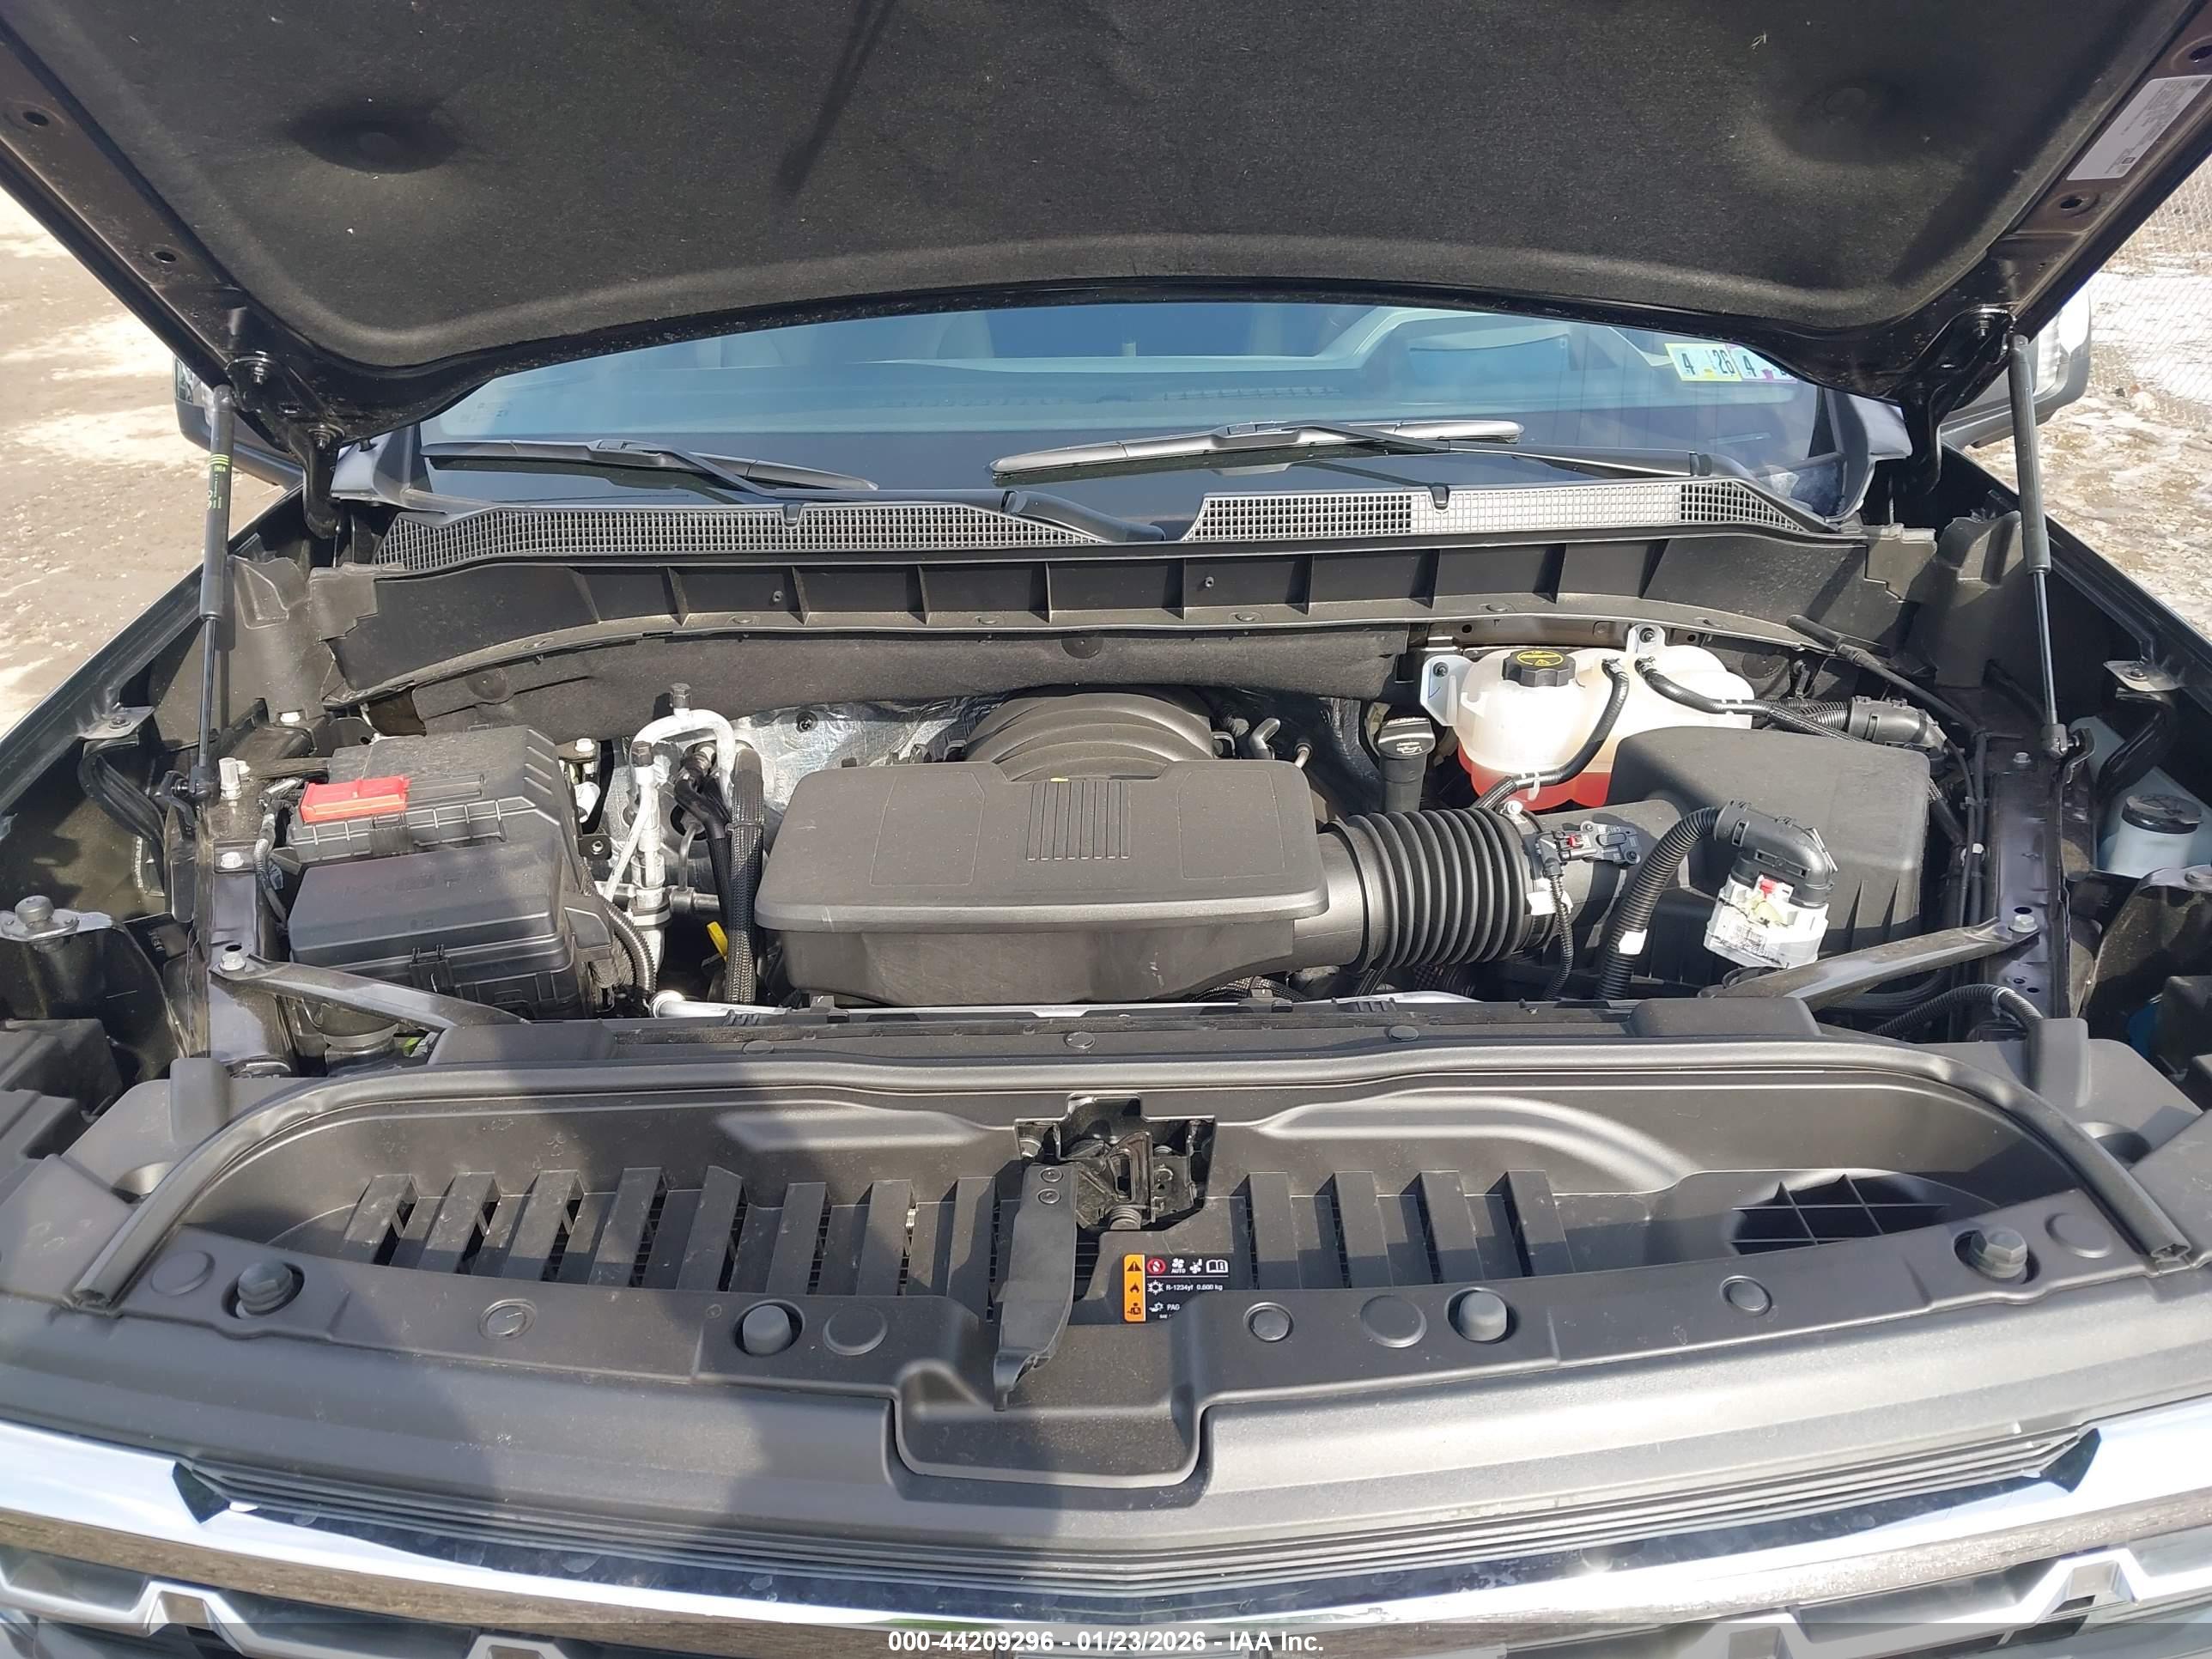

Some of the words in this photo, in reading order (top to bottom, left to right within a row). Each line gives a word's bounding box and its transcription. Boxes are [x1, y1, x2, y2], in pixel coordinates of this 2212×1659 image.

[1680, 353, 1696, 375] 4
[1712, 349, 1735, 374] 26
[1742, 355, 1757, 377] 4
